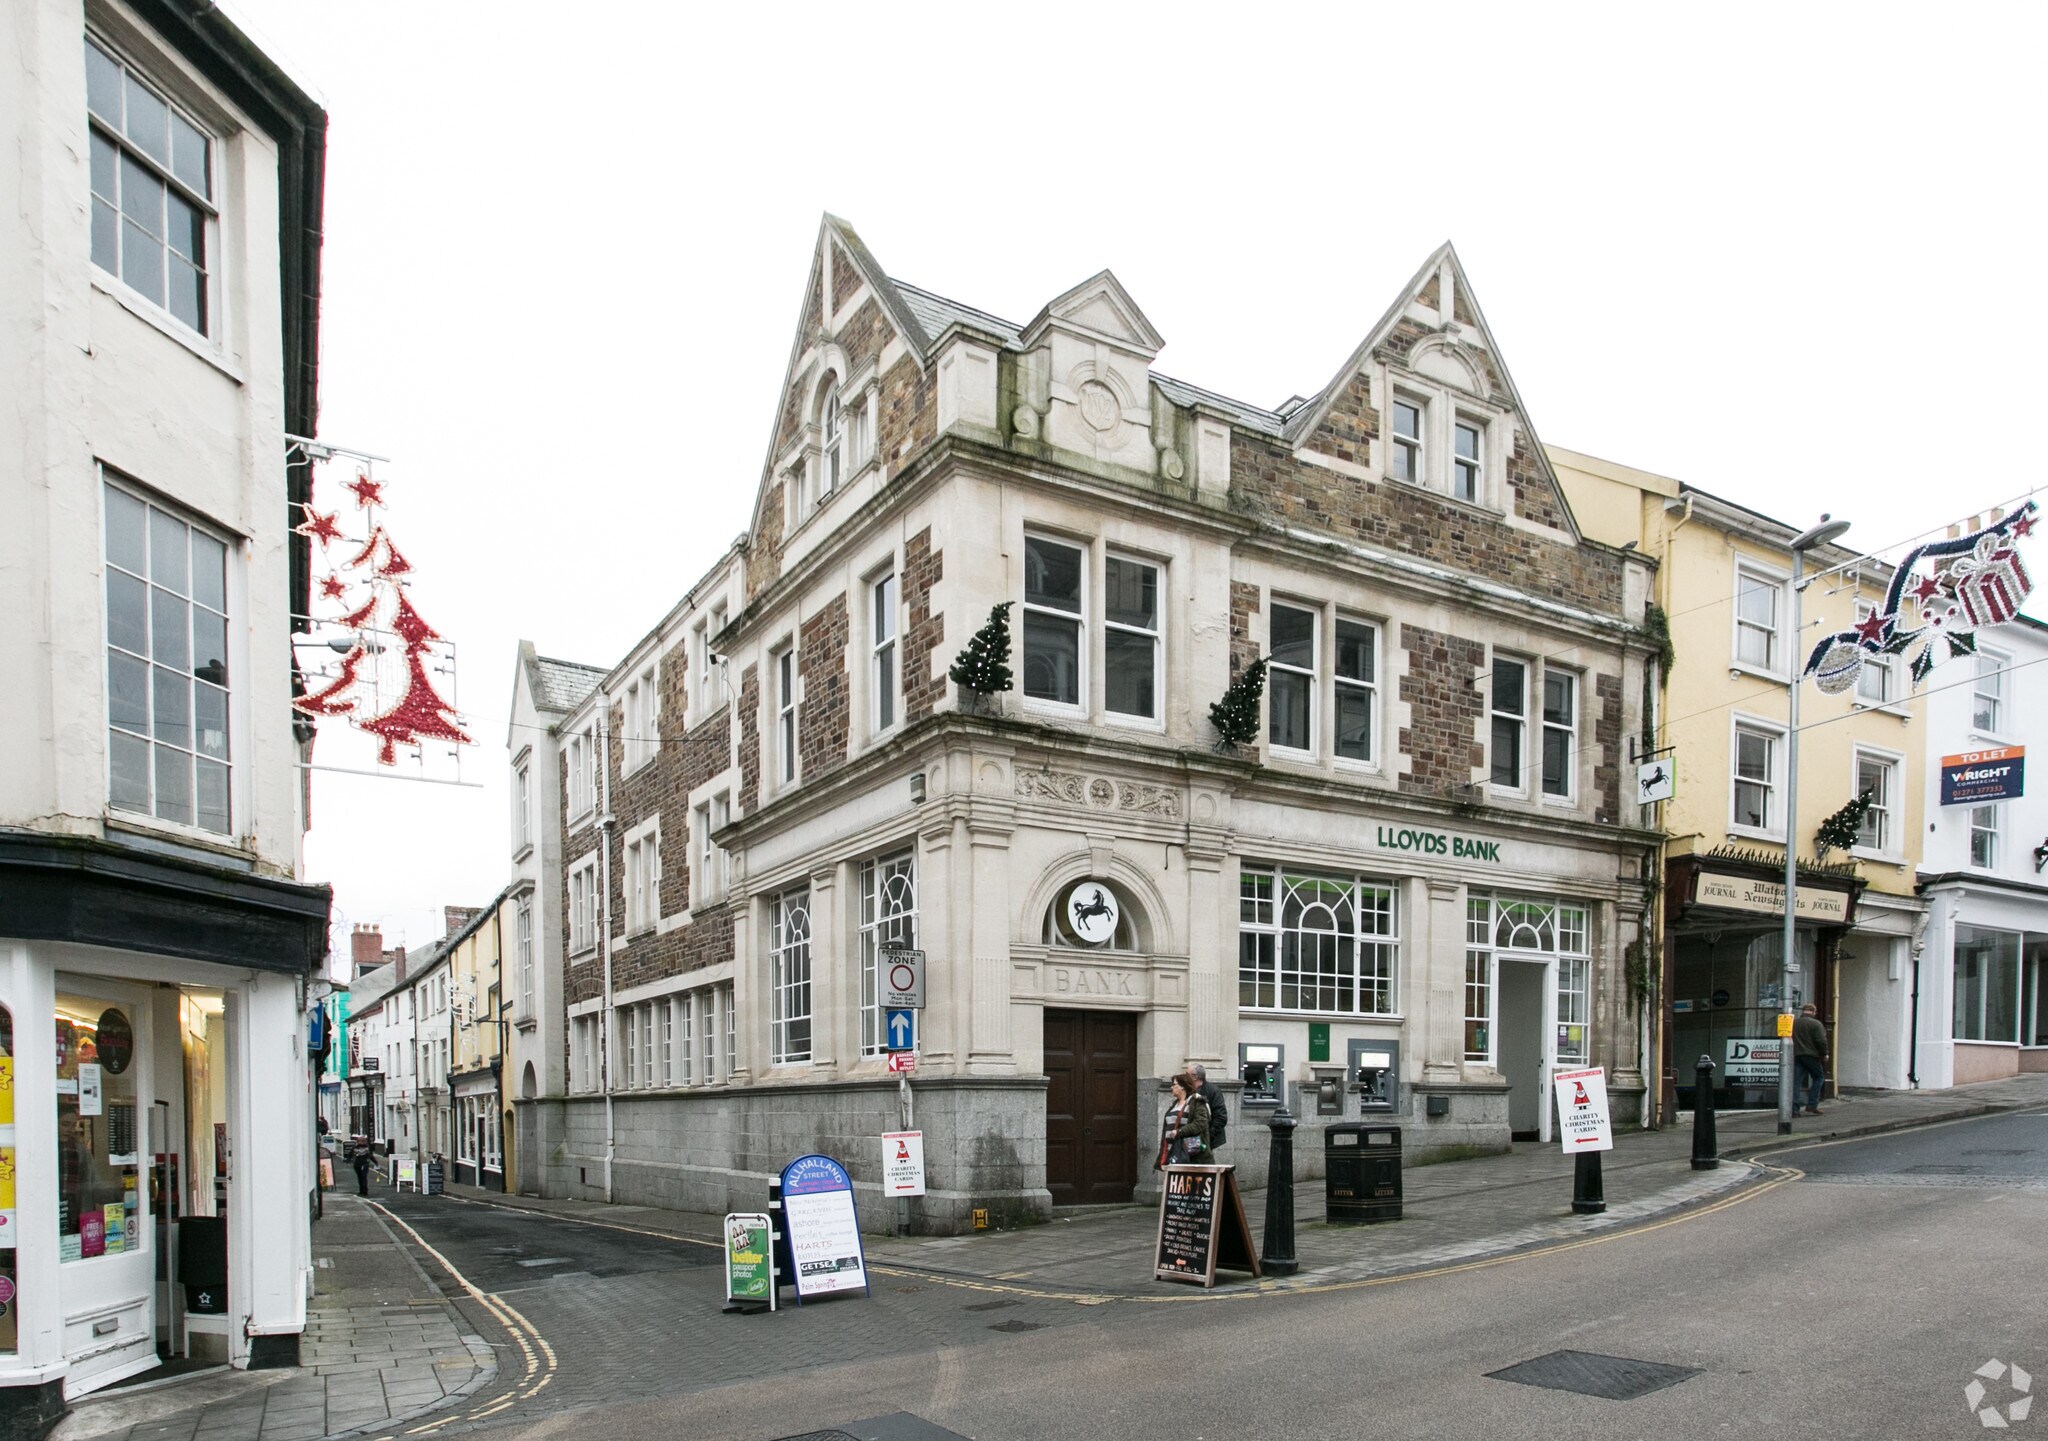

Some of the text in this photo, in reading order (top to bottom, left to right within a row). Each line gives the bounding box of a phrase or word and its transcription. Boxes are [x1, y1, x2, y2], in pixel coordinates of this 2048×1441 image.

[1961, 749, 2008, 763] TO LET
[1951, 766, 2011, 782] WRIGHT
[1957, 778, 1998, 787] COMMERCIAL
[1952, 785, 2003, 797] 01271 377333
[1378, 826, 1501, 862] LLOYDS BANK
[1703, 886, 1737, 899] JOURNAL
[1812, 901, 1842, 912] JOURNAL
[888, 956, 916, 965] ZONE
[1569, 1113, 1599, 1121] CHARITY
[1565, 1119, 1605, 1128] CHRISTMAS
[789, 1159, 842, 1187] ALLHALLAND
[803, 1171, 829, 1179] STREET
[1169, 1174, 1212, 1196] HARTS
[86, 1222, 100, 1230] FREE
[793, 1218, 820, 1229] ashore
[796, 1240, 832, 1251] HARTS
[731, 1250, 763, 1264] better
[732, 1264, 757, 1272] passport
[732, 1271, 753, 1279] photos
